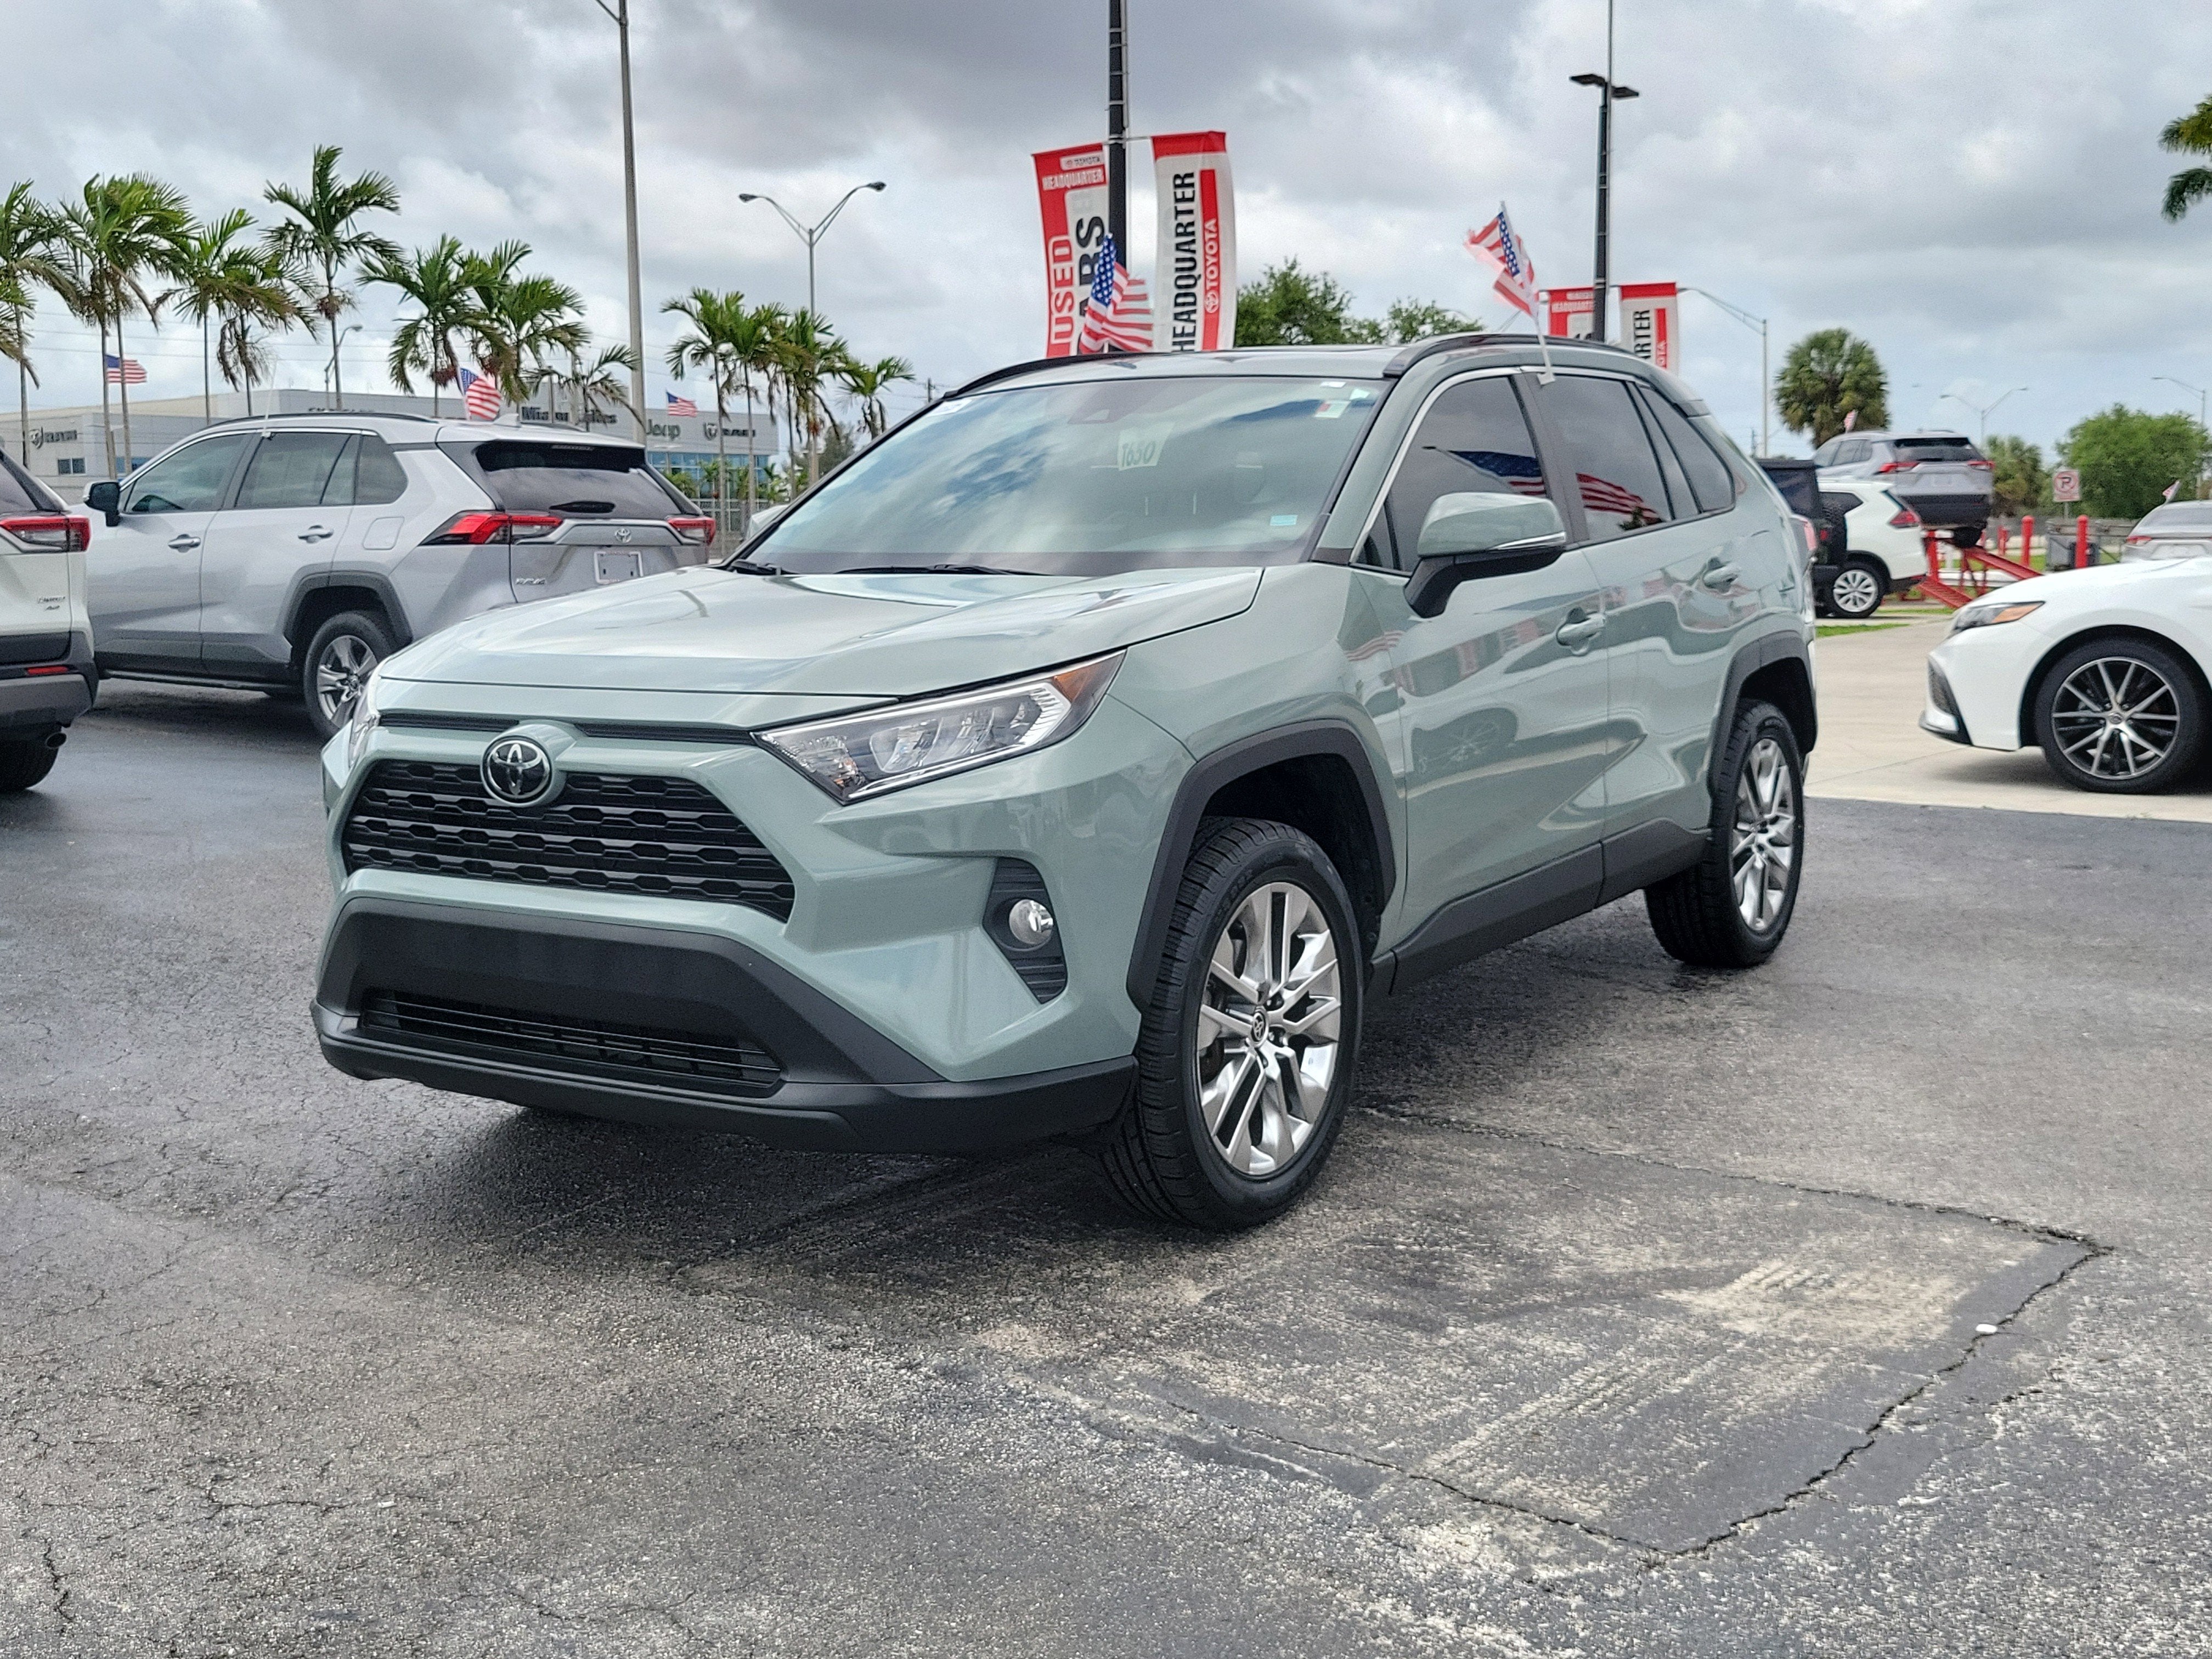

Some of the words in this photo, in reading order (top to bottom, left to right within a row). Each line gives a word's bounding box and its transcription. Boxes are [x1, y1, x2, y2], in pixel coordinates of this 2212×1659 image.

[1050, 237, 1074, 342] USED
[1172, 171, 1201, 352] HEADQUARTER
[1205, 218, 1219, 290] TOYOTA
